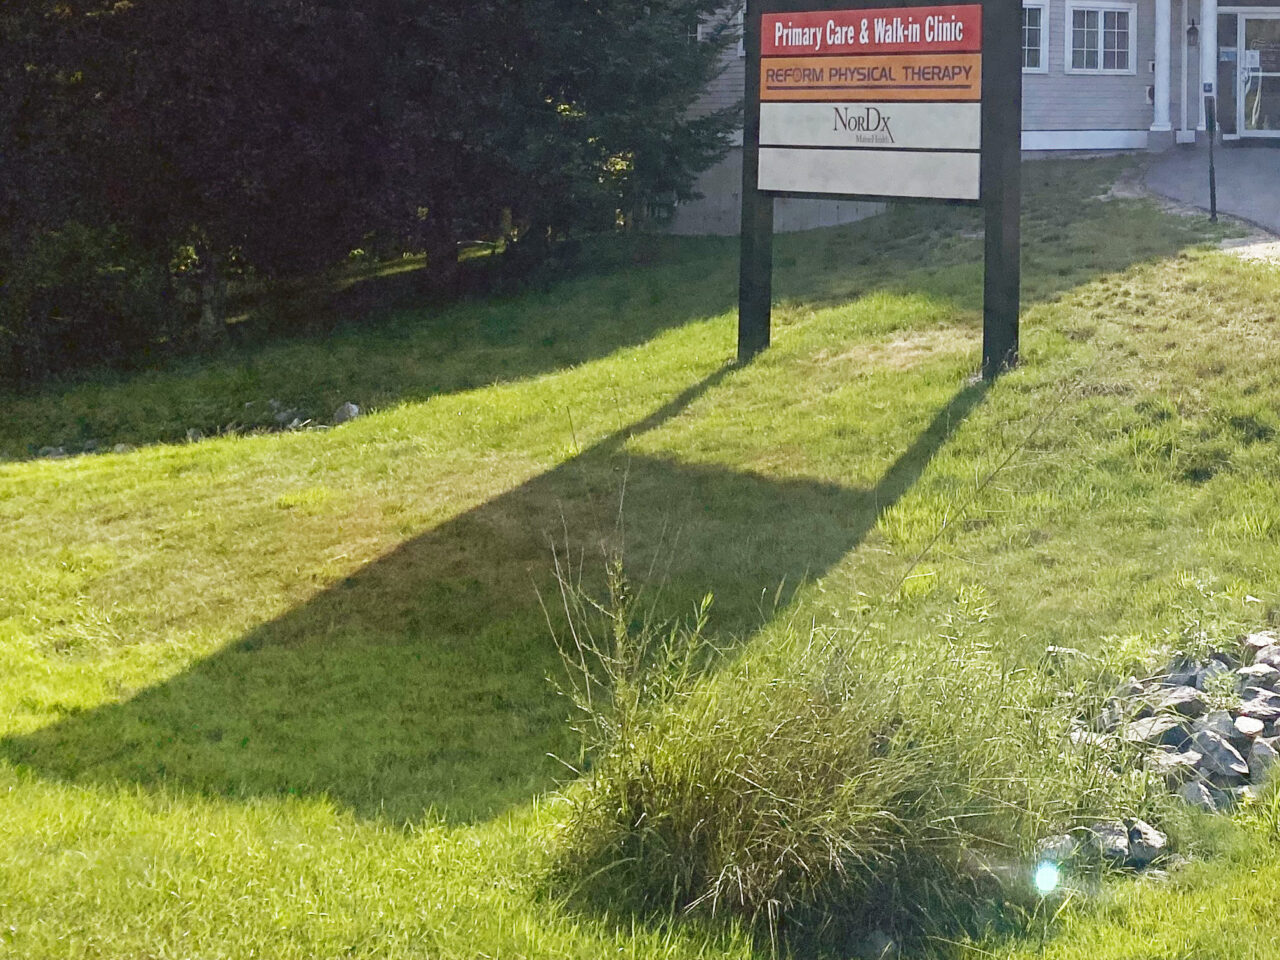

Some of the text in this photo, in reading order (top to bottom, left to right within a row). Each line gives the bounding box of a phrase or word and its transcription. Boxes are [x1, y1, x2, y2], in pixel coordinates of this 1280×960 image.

[775, 14, 964, 51] Primary Care & Walk-in Clinic
[766, 65, 973, 84] REFORM PHYSICAL THERAPY
